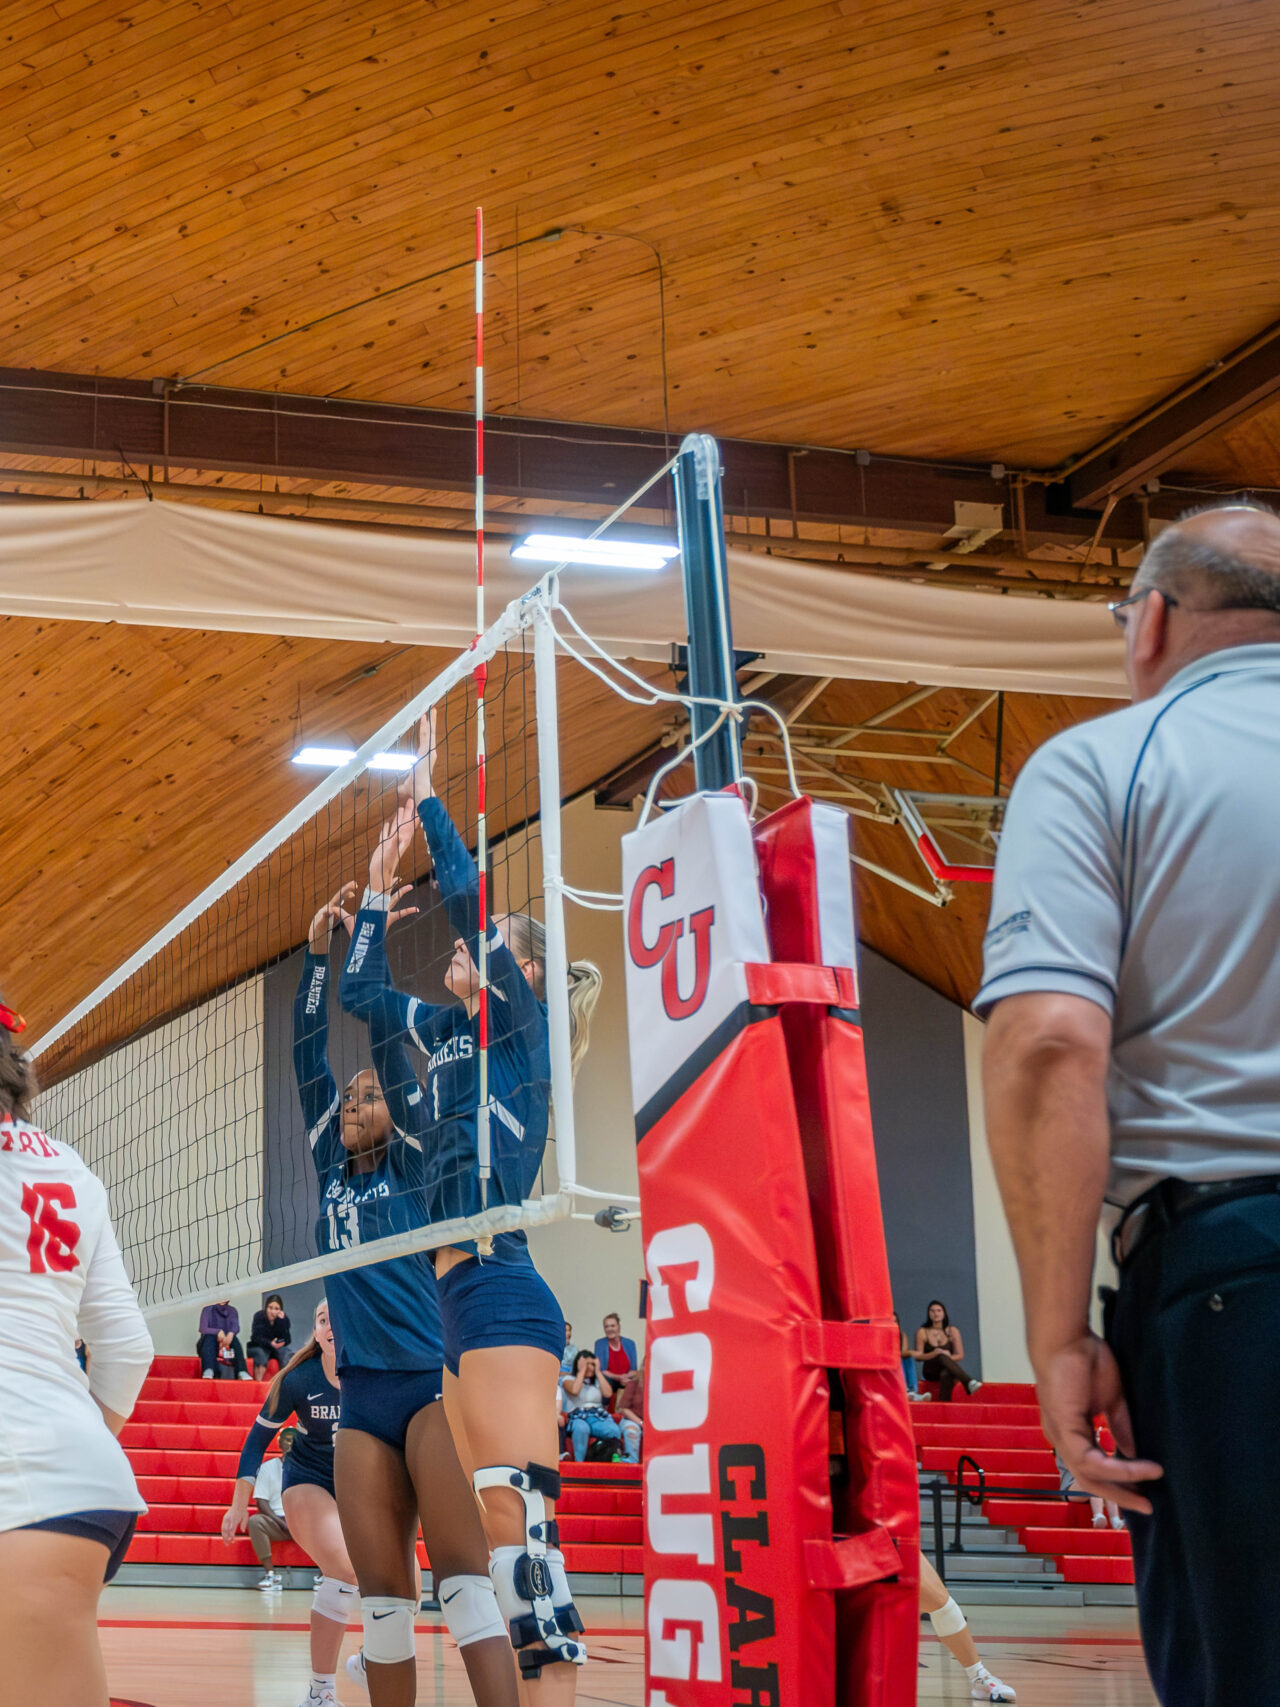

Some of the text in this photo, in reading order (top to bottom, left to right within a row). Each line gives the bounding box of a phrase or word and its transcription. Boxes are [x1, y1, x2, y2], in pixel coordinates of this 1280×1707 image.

[305, 966, 326, 1014] BRANDEIS
[627, 857, 715, 1021] CU
[327, 1202, 361, 1249] 13
[646, 1223, 723, 1707] COUG
